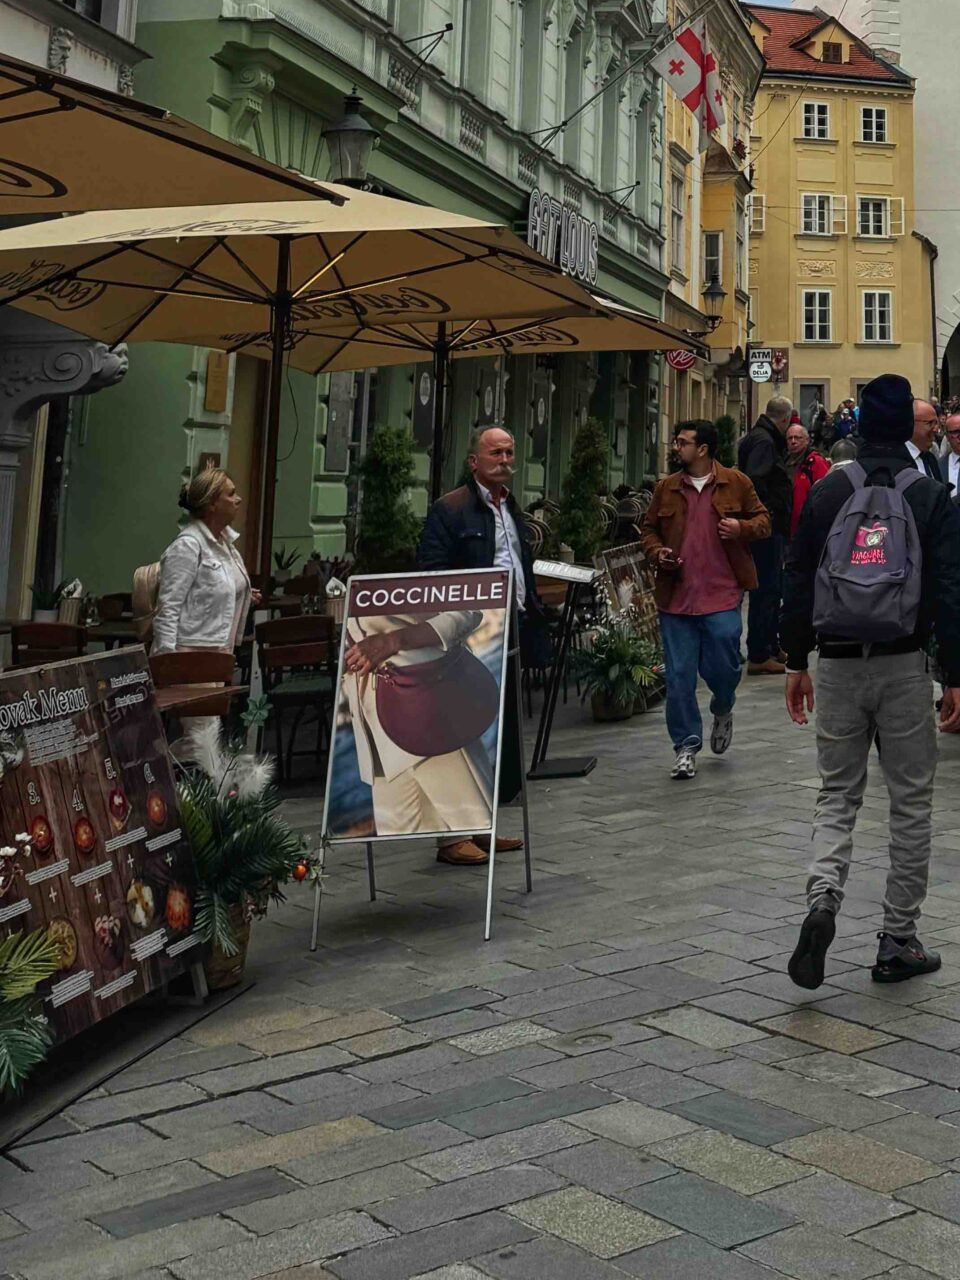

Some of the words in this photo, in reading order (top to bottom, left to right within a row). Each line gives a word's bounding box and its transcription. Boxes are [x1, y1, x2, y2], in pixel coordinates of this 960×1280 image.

[750, 351, 771, 360] ATM
[356, 582, 504, 607] COCCINELLE
[0, 690, 41, 731] ovak
[38, 687, 90, 720] Menu
